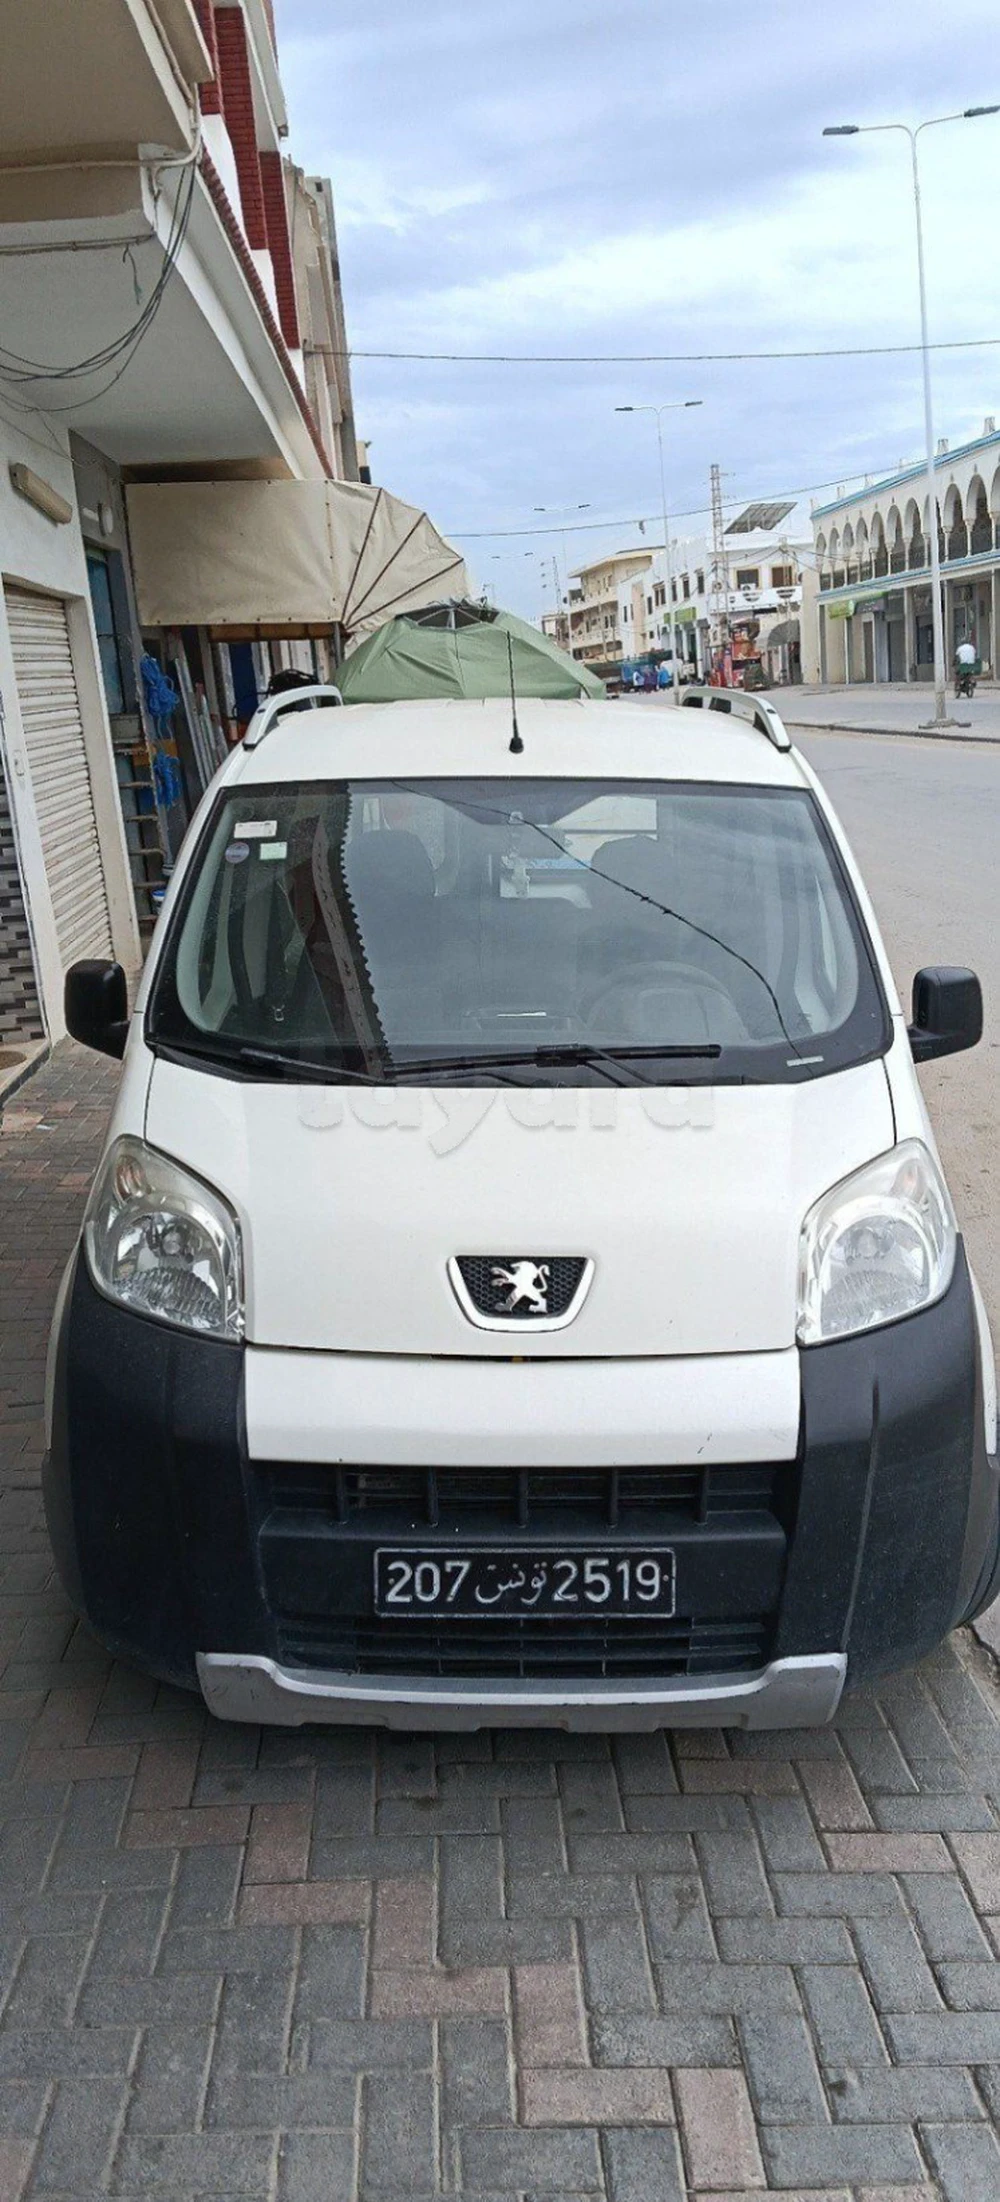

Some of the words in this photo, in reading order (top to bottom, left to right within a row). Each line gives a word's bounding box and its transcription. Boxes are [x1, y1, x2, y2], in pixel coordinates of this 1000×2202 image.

[385, 1560, 472, 1603] 207
[475, 1561, 547, 1605] تونس
[553, 1558, 662, 1603] 2519
